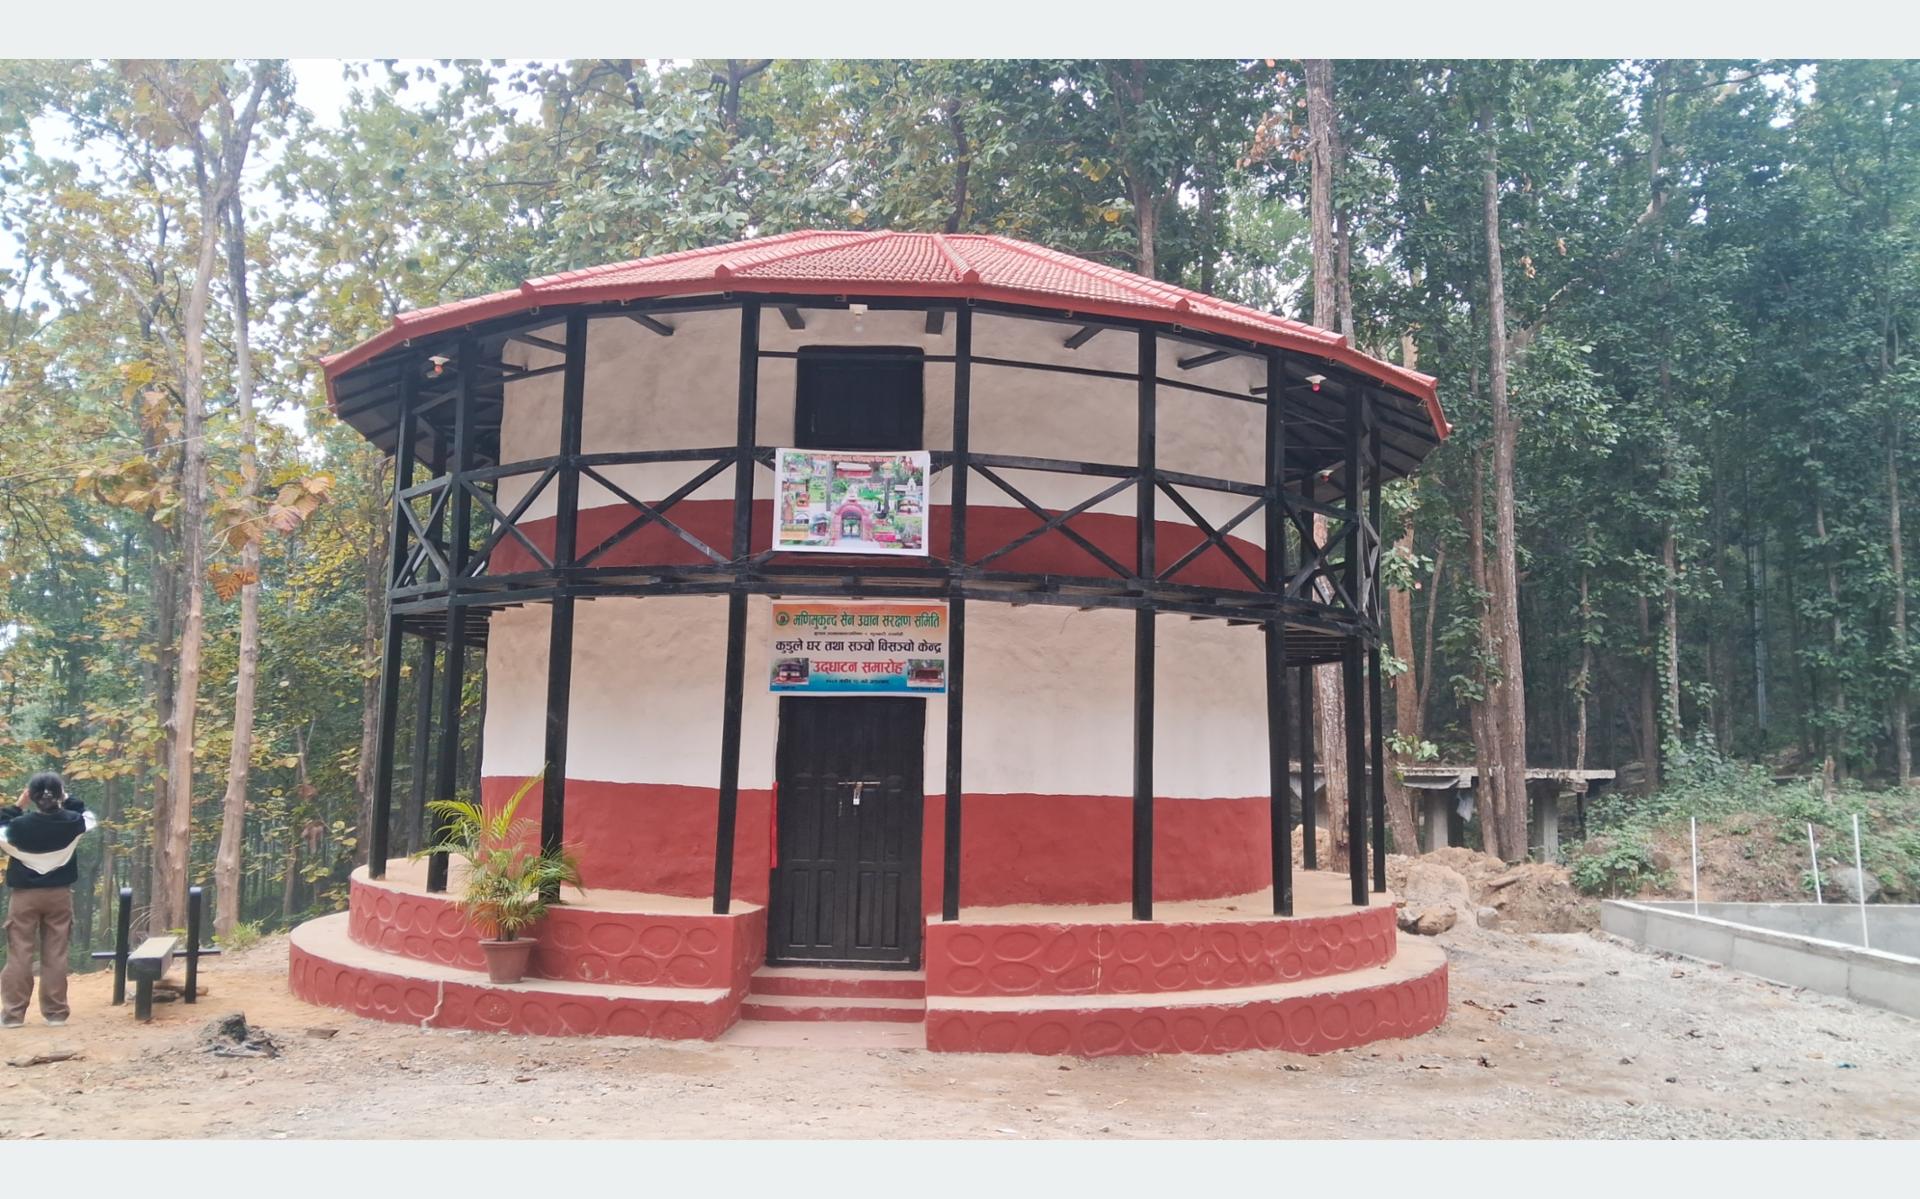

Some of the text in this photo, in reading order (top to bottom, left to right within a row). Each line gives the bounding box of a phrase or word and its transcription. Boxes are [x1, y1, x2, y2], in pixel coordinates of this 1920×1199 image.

[840, 611, 854, 627] सेन
[914, 611, 940, 628] समिति
[807, 640, 821, 651] घर
[825, 641, 844, 652] तथा
[918, 639, 942, 654] केन्द्र
